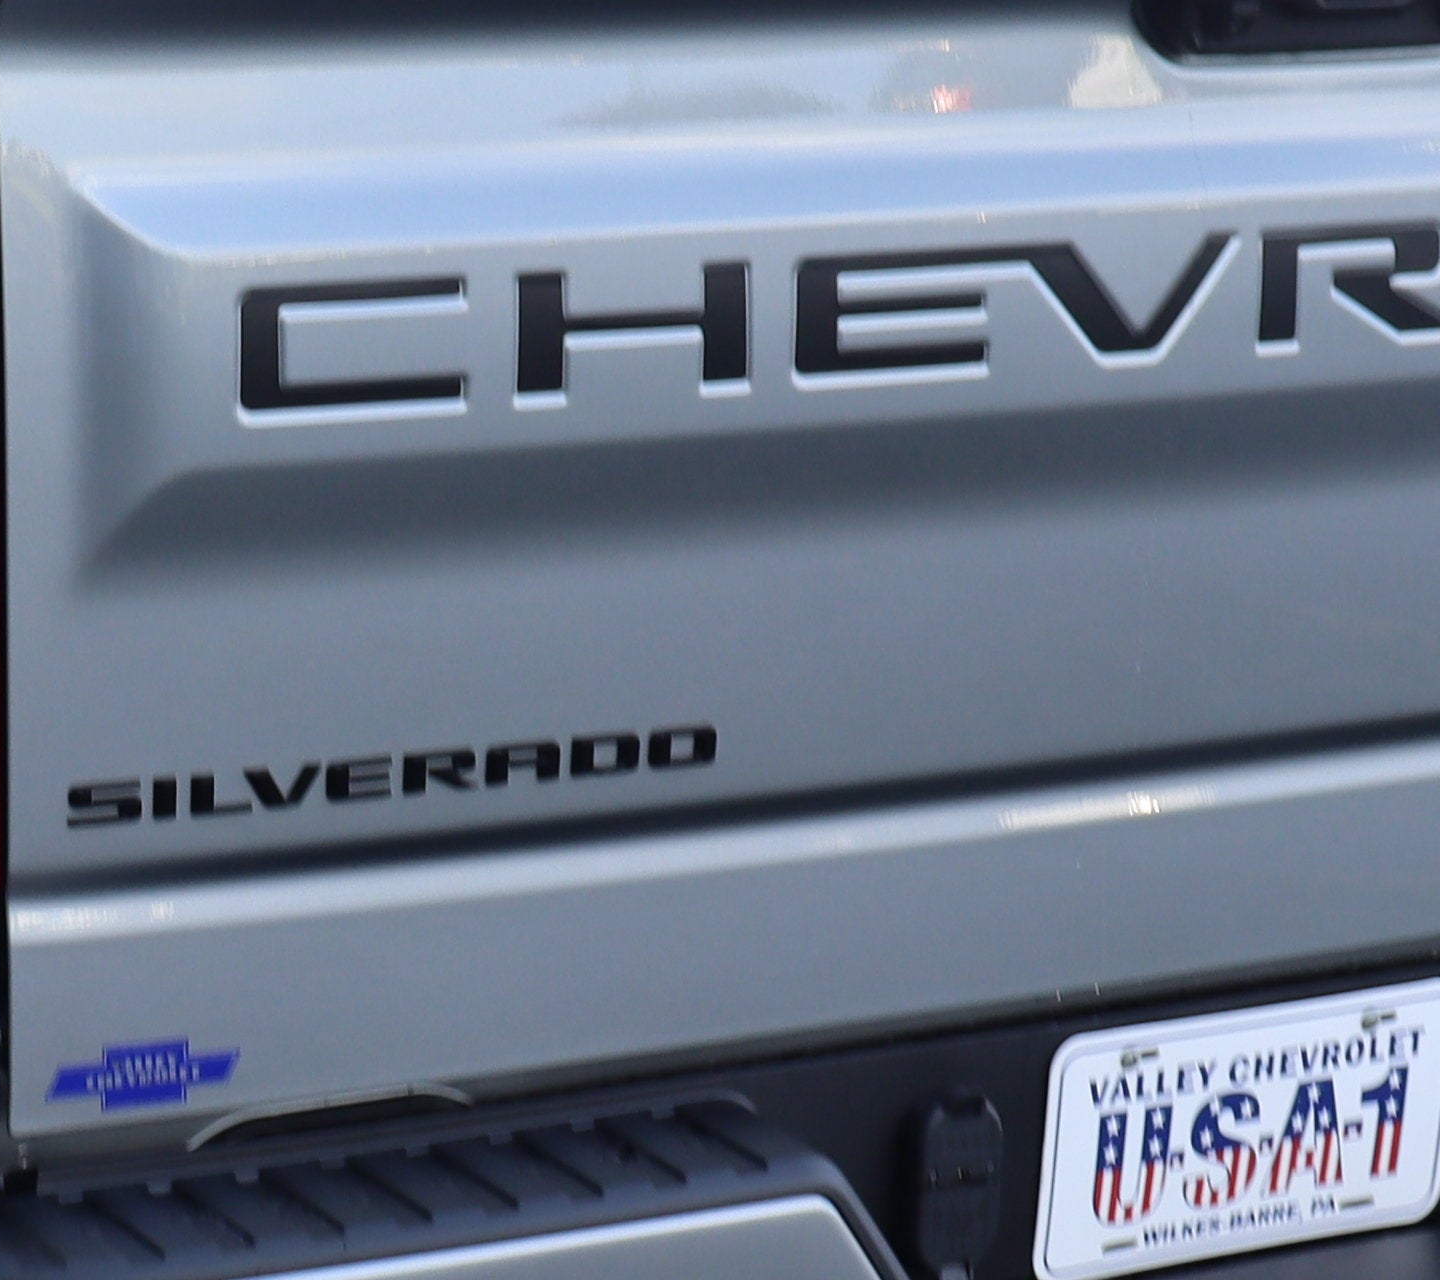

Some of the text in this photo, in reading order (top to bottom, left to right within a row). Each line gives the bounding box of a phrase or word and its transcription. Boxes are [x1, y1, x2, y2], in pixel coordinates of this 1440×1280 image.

[66, 724, 718, 829] SILVERADO
[1089, 1024, 1425, 1110] VALLEY CHEVROLET
